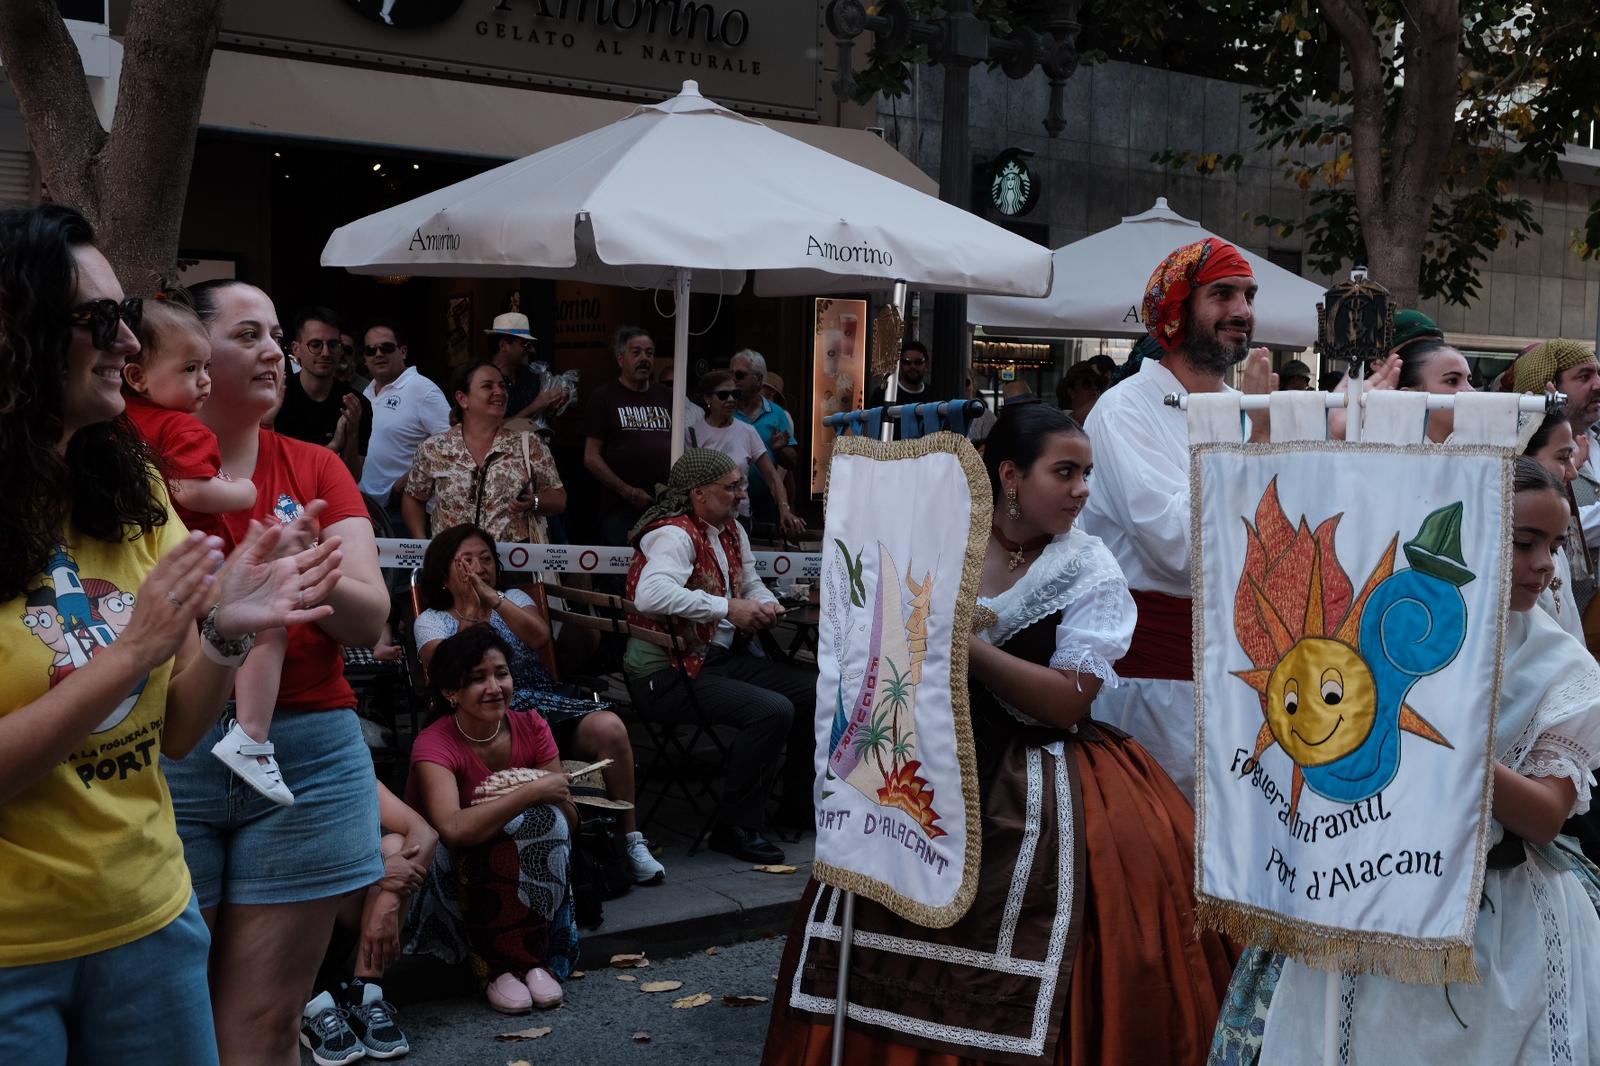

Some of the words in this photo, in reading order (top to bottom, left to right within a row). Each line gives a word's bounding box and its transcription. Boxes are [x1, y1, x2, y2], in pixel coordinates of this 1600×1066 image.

[476, 21, 575, 48] GELATO
[596, 40, 623, 55] AL
[642, 45, 761, 75] NATURALE
[496, 0, 748, 47] morino
[409, 227, 461, 251] Amorino
[806, 235, 893, 266] Amorino
[833, 656, 879, 764] FOGUERA
[76, 738, 155, 789] PORT
[81, 750, 98, 759] LA
[100, 726, 149, 753] FOGUERA
[1230, 748, 1292, 826] Foguera
[816, 809, 850, 831] ORT
[864, 812, 949, 875] D'ALACANT
[1265, 847, 1297, 893] Port
[1306, 850, 1444, 900] d'Alacant
